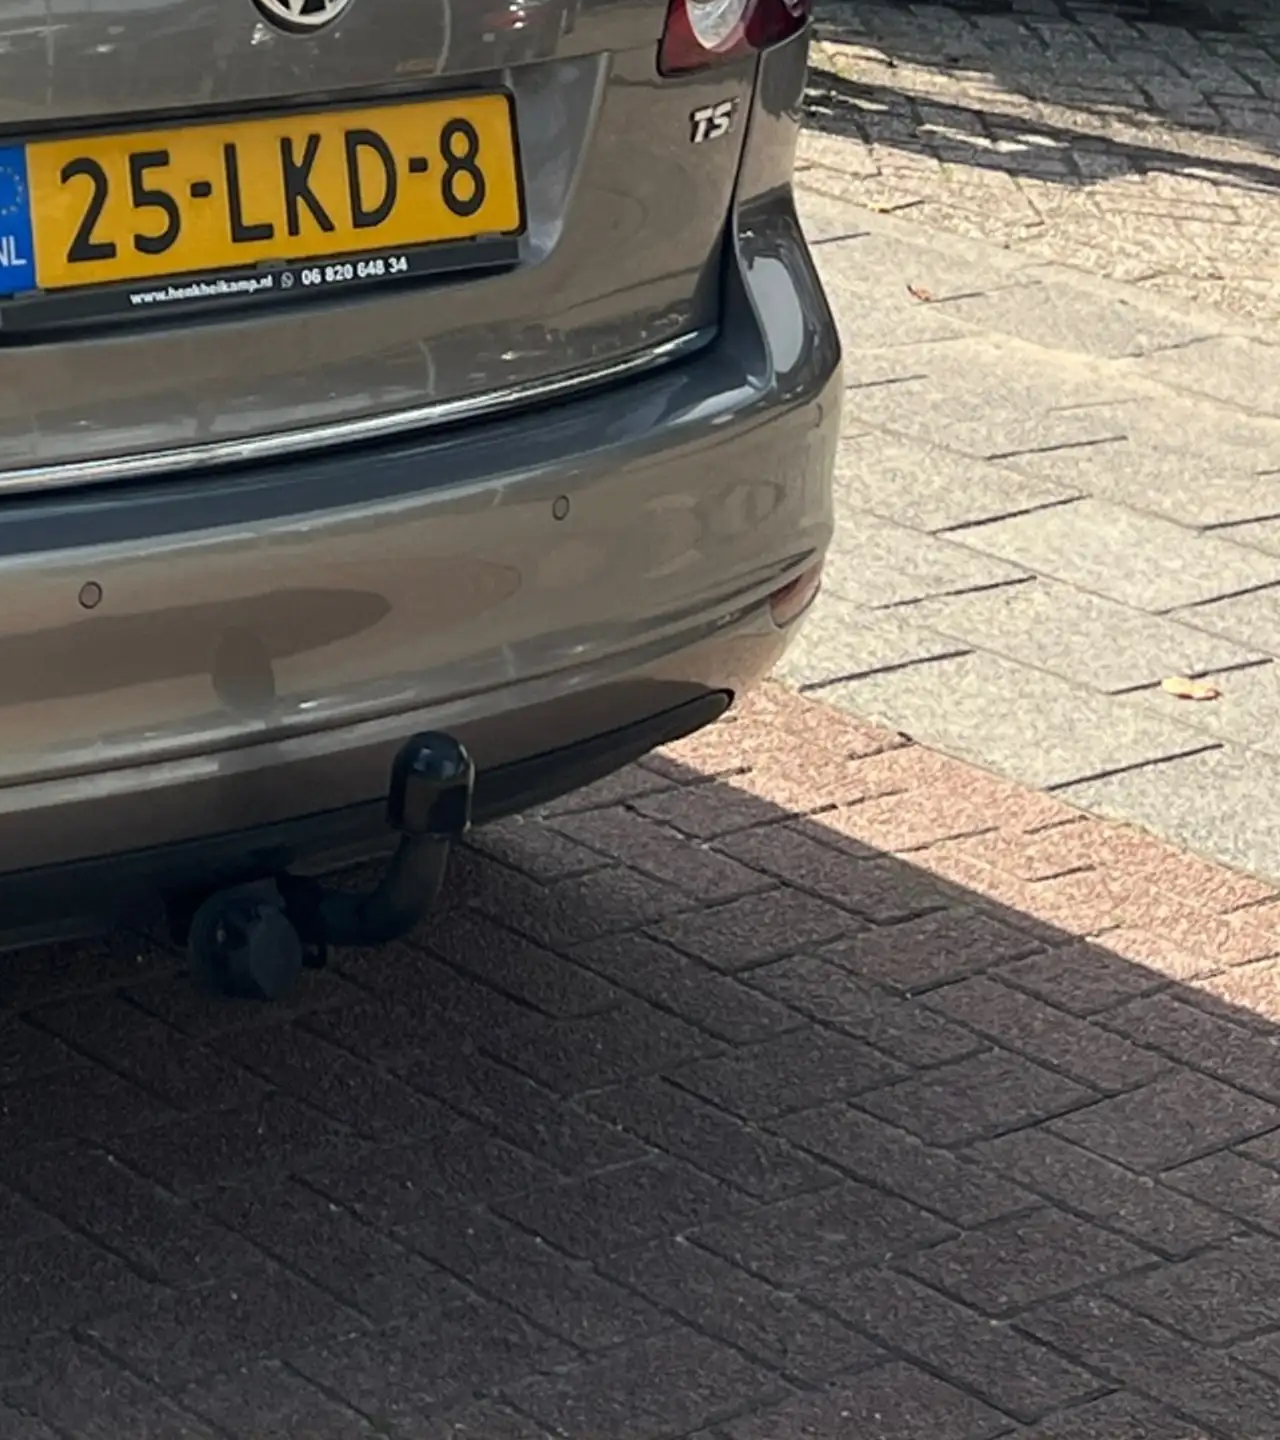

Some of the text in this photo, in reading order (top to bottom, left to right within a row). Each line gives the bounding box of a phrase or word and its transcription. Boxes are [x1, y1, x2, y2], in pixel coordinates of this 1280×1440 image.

[60, 117, 486, 264] 25-LKD-8
[301, 268, 322, 286] 06
[324, 263, 354, 282] 820
[387, 256, 408, 273] 34
